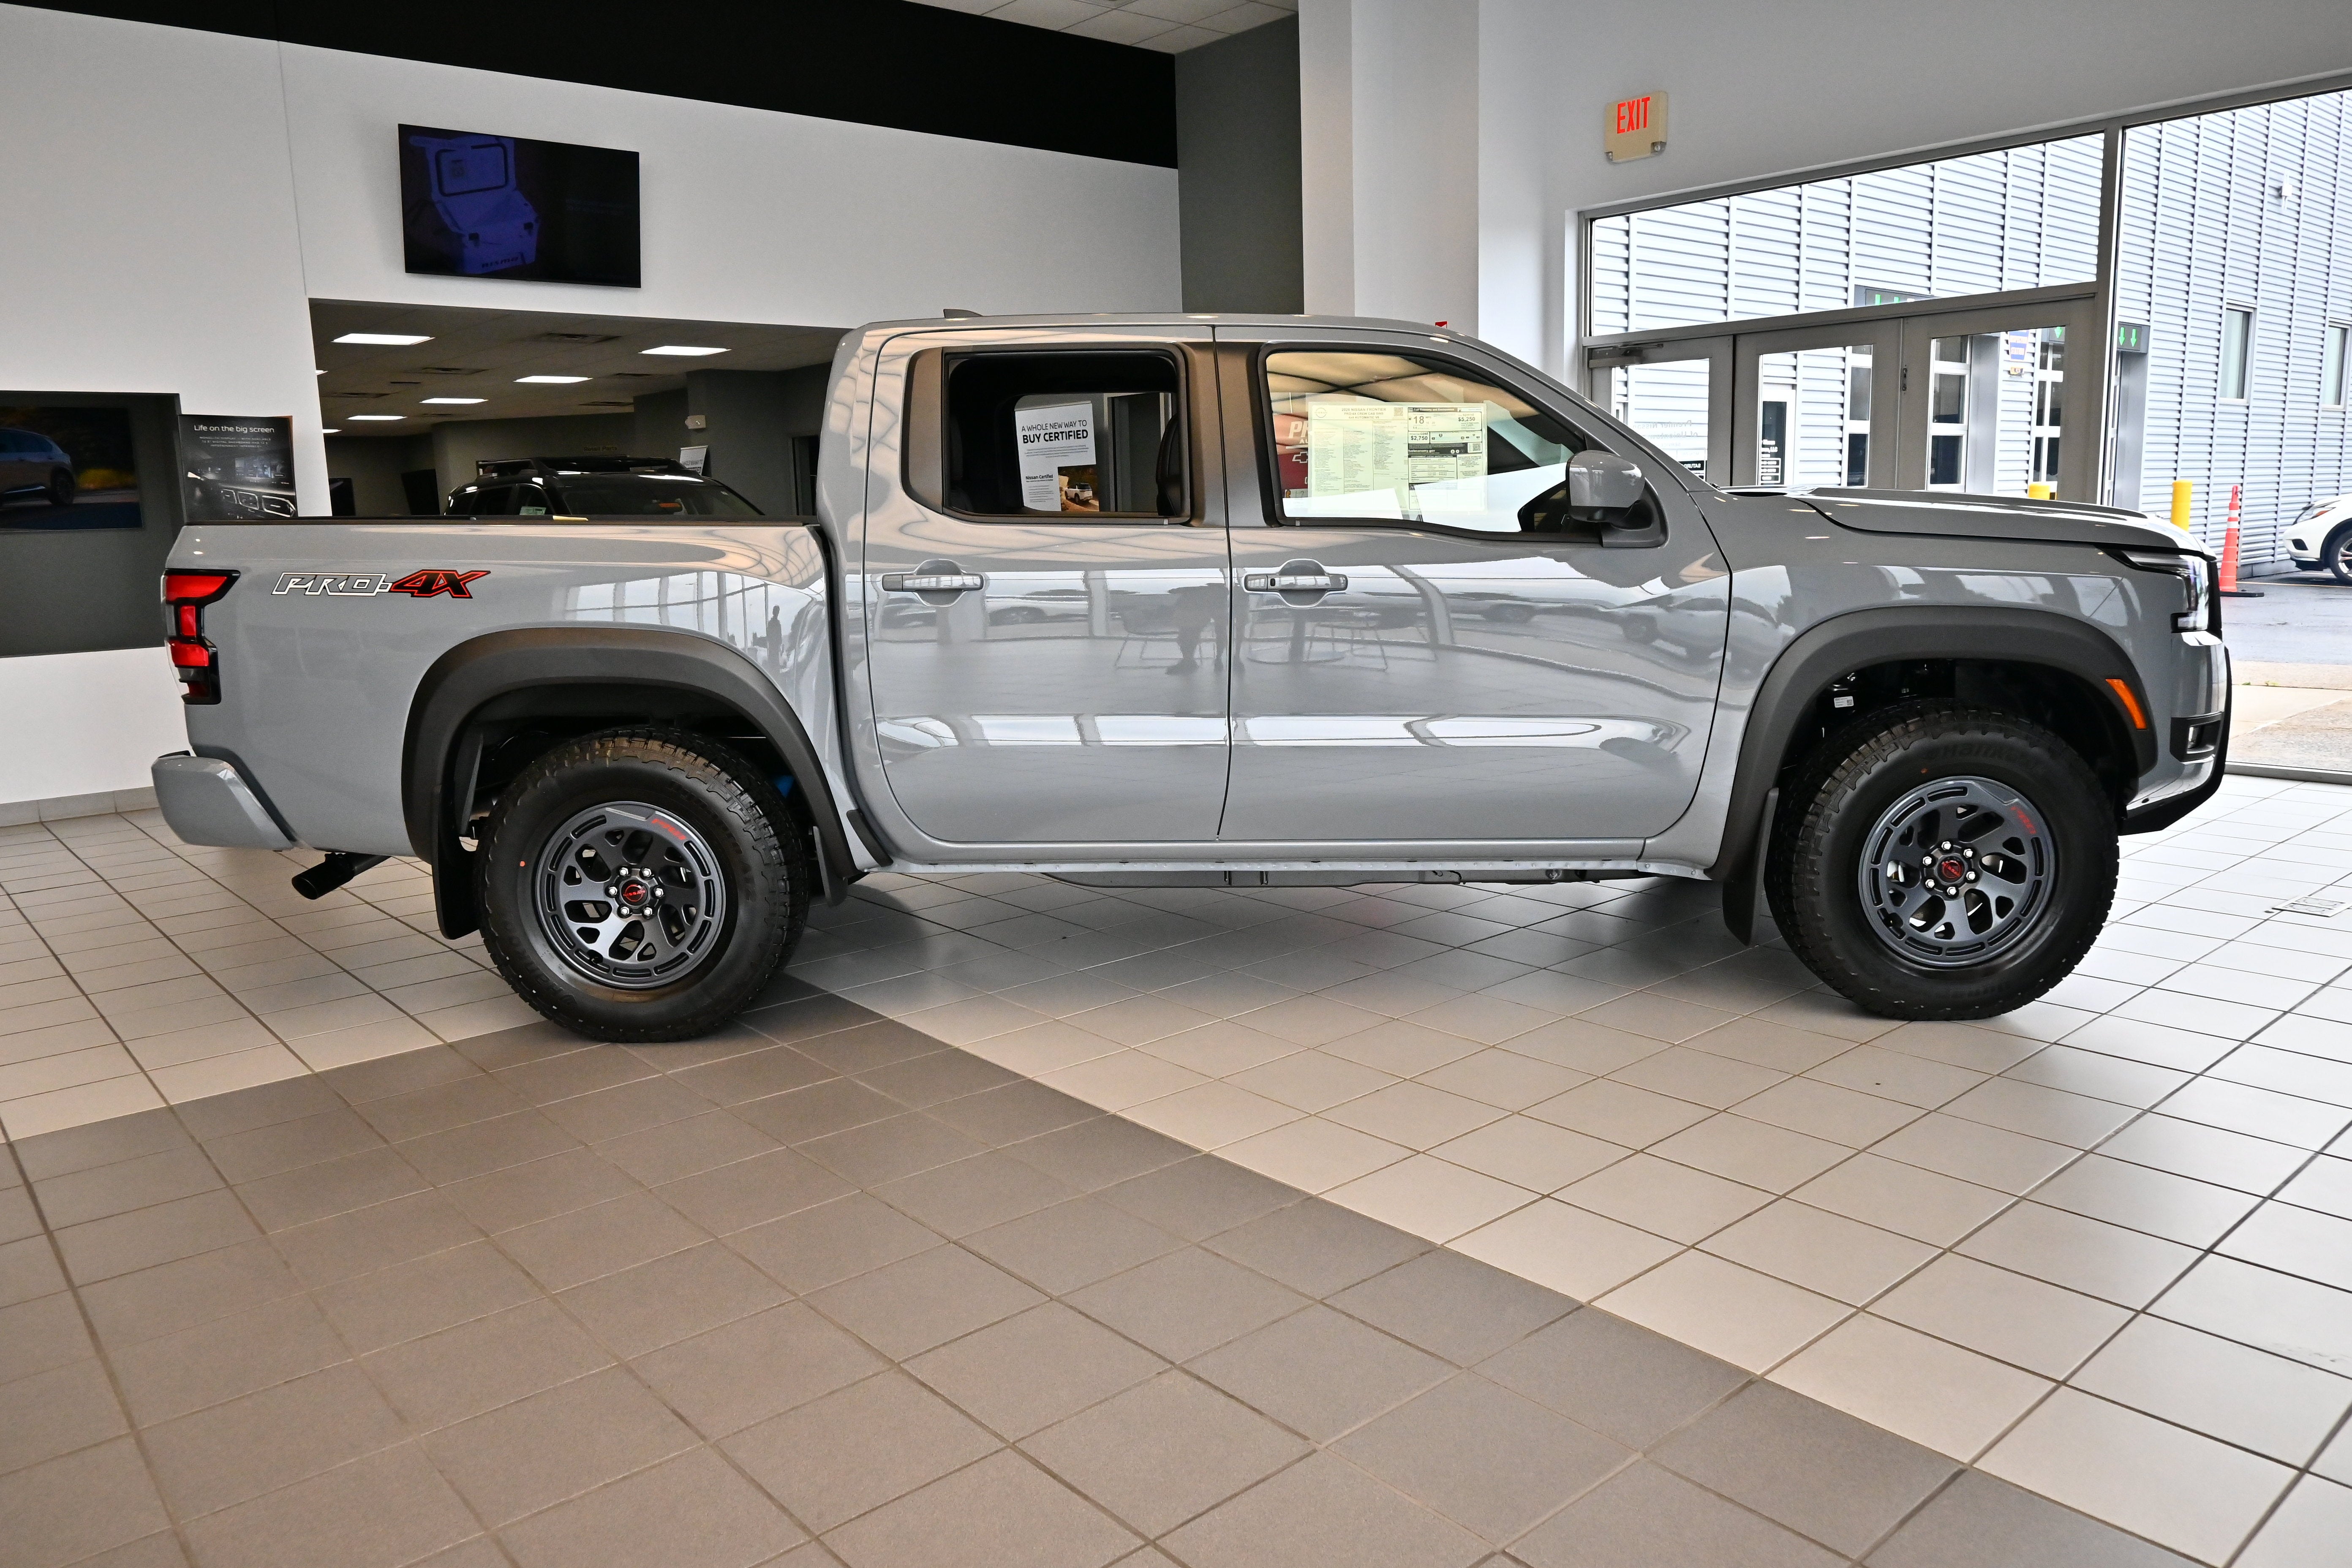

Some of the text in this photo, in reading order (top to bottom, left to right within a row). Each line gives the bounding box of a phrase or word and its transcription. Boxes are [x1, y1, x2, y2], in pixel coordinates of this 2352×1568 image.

[1617, 96, 1651, 134] EXIT
[1026, 423, 1048, 432] WHOLE
[1413, 416, 1424, 424] 18
[1023, 429, 1088, 444] BUY CERTIFIED
[271, 569, 491, 599] PRO-4X
